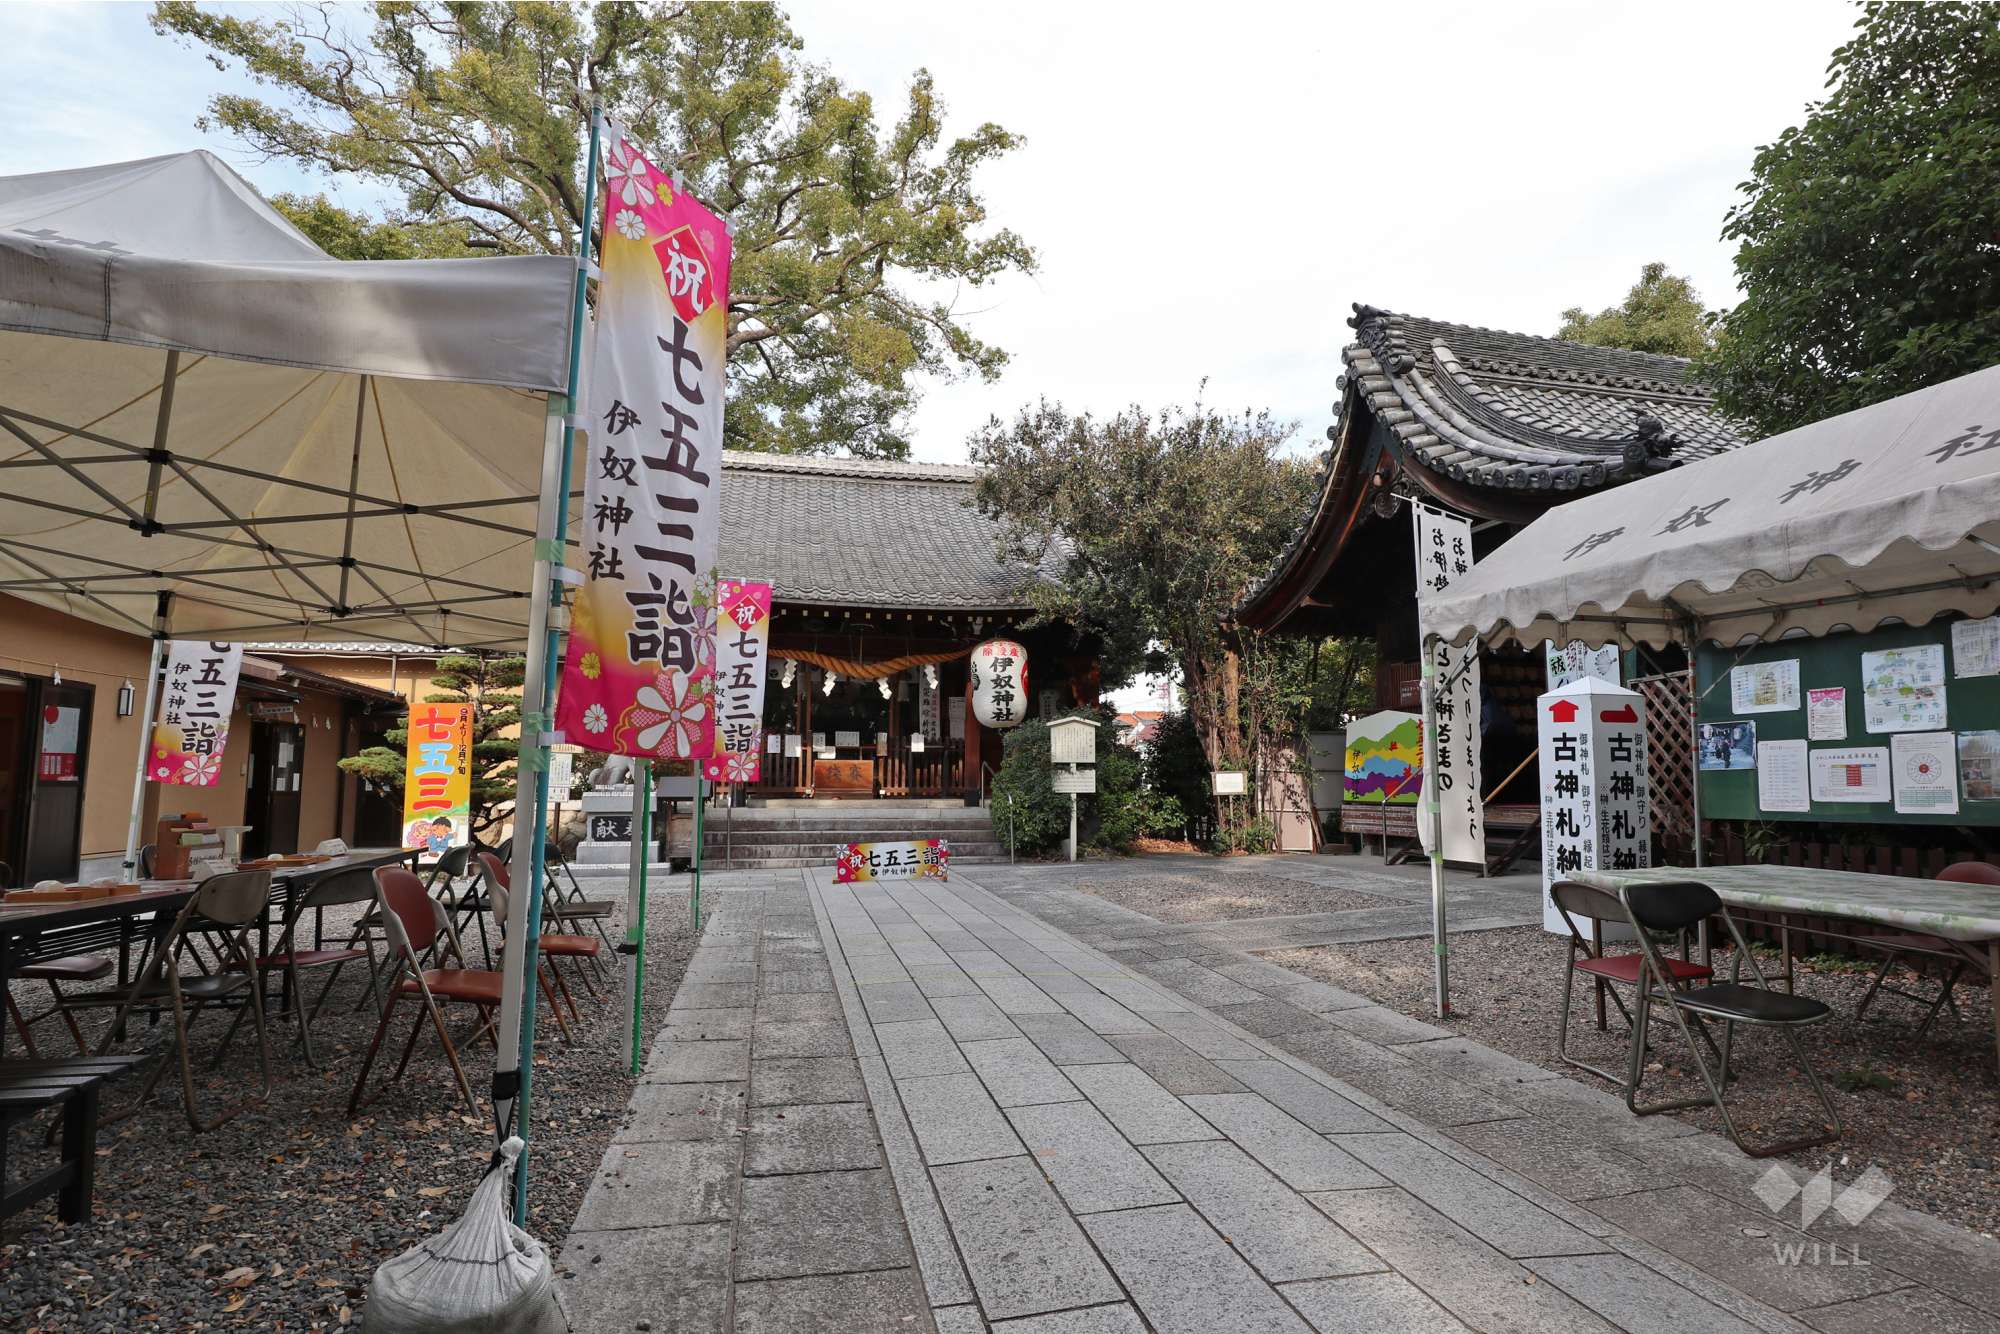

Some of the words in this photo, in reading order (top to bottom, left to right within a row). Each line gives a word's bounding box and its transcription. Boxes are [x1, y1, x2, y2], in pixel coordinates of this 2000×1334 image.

[666, 239, 704, 314] 祝
[588, 399, 641, 582] 伊奴神社
[626, 316, 711, 675] 七五三詣
[735, 603, 757, 625] 祝
[166, 662, 192, 725] 伊奴神社
[723, 631, 759, 753] 七五三詣
[990, 656, 1015, 722] 伊奴神社
[413, 707, 457, 811] 七五三
[850, 854, 864, 868] 祝
[865, 847, 940, 868] 七五三詣
